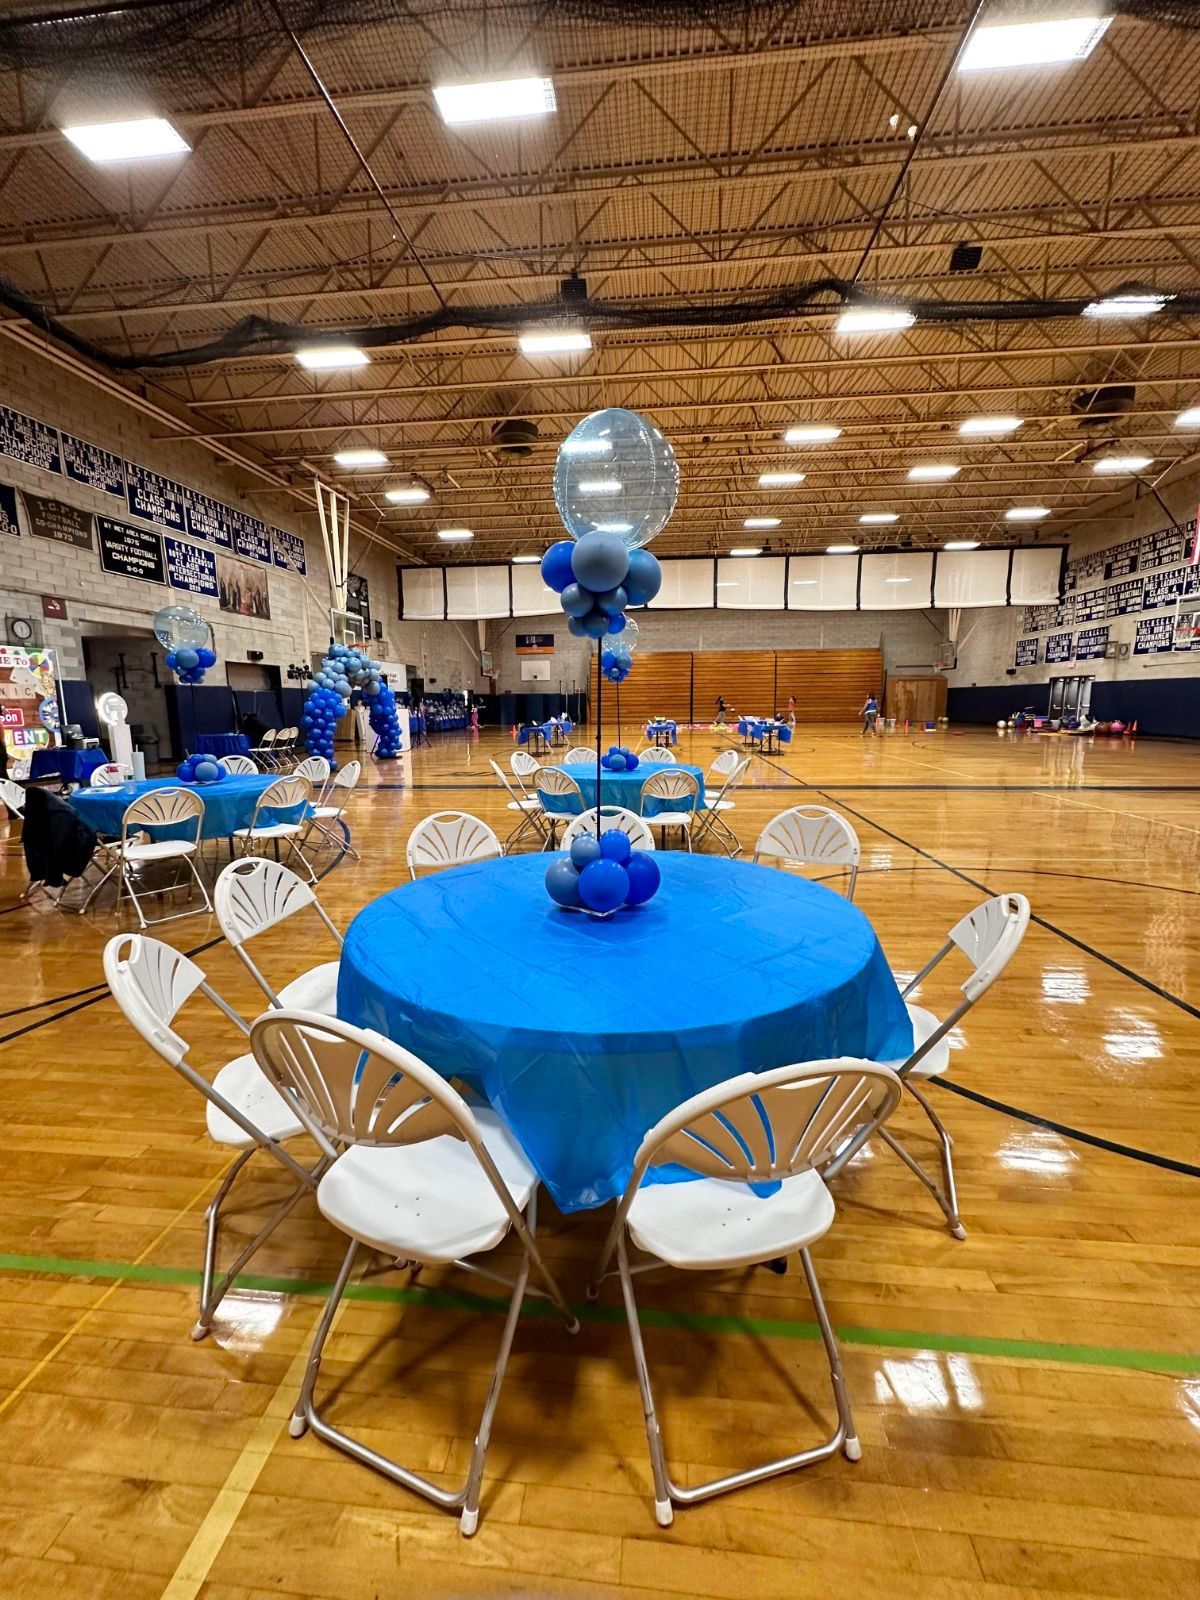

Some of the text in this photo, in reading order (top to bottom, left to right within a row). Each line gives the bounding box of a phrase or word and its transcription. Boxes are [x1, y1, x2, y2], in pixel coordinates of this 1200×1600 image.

[24, 434, 58, 456] SCHOOL
[64, 452, 122, 482] SMALL SCHOOL
[73, 463, 117, 487] CHAMPIONS
[134, 497, 180, 522] CHAMPIONS
[137, 488, 175, 511] CLASS A
[36, 518, 88, 538] CO-CHAMPIONS
[190, 510, 227, 532] DIVISION A
[191, 519, 227, 541] CHAMPIONS
[236, 537, 268, 557] CHAMPIONS
[239, 530, 264, 547] CLASS A
[105, 540, 158, 560] VARSITY FOOTBALL
[112, 552, 155, 568] CHAMPIONS
[175, 558, 209, 574] CLASS A
[187, 554, 213, 569] LACROSSE
[168, 563, 215, 583] INTERSECTIONAL
[173, 572, 214, 589] CHAMPIONS
[1160, 574, 1183, 587] LACROSSE
[1146, 589, 1179, 606] CHAMPIONS
[1149, 584, 1176, 597] CLASS A
[1137, 639, 1169, 648] CHAMPIONS
